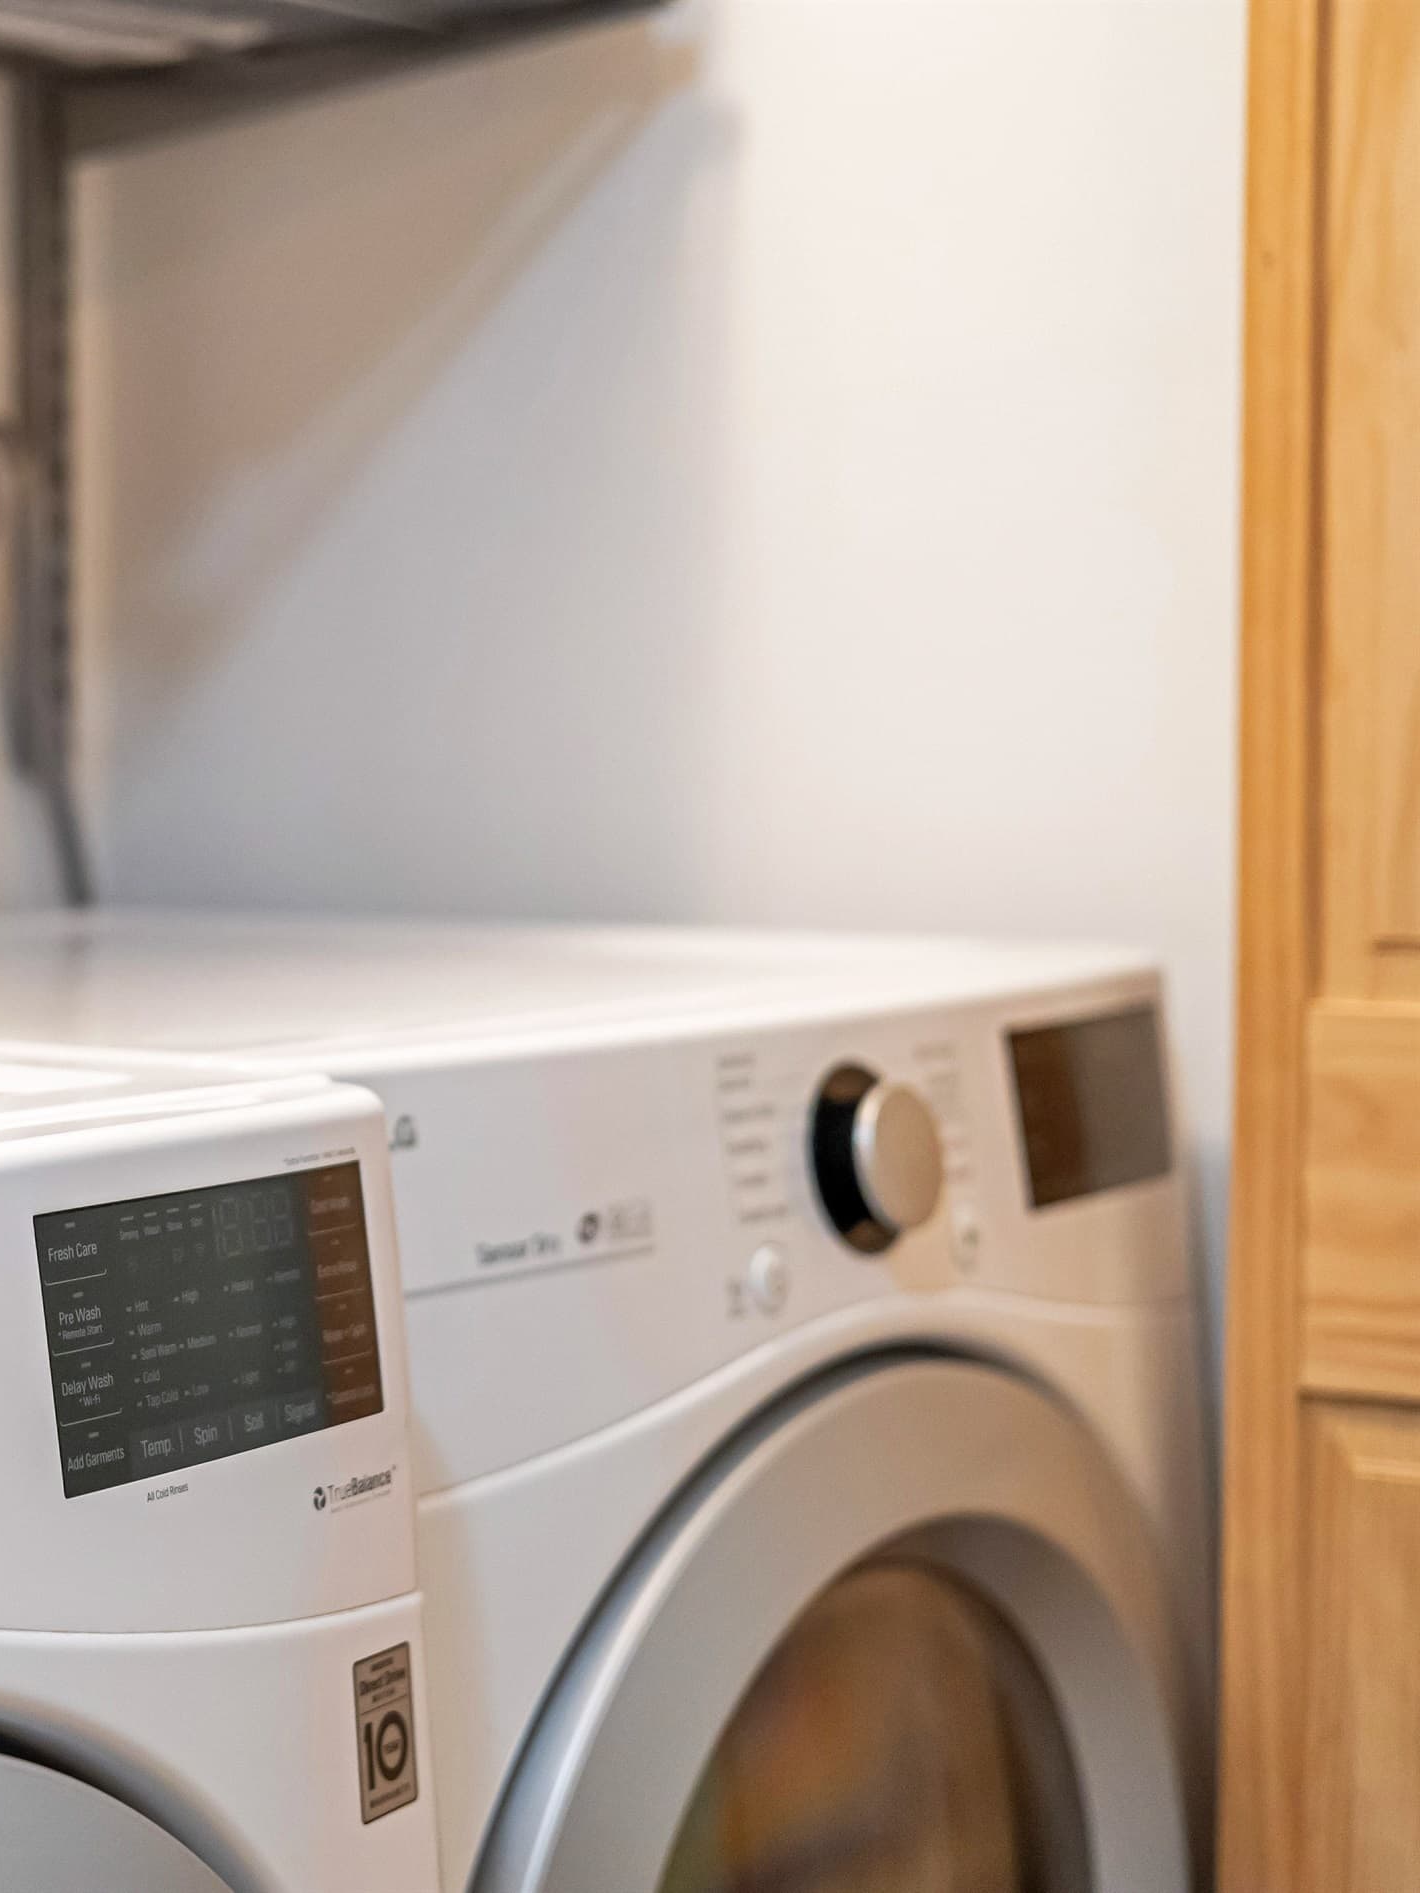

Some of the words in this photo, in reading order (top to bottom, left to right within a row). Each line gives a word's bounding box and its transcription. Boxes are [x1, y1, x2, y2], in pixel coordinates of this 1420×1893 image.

[47, 1246, 75, 1263] Fresh
[75, 1241, 99, 1259] Care
[58, 1311, 75, 1326] Pre
[75, 1305, 102, 1323] Wash
[61, 1380, 87, 1398] Delay
[87, 1372, 115, 1391] Wash
[193, 1424, 219, 1446] Spin
[140, 1436, 175, 1459] Temp.
[67, 1455, 84, 1472] Add
[84, 1446, 125, 1468] Garments
[155, 1486, 169, 1500] Cold
[364, 1710, 408, 1791] 10
